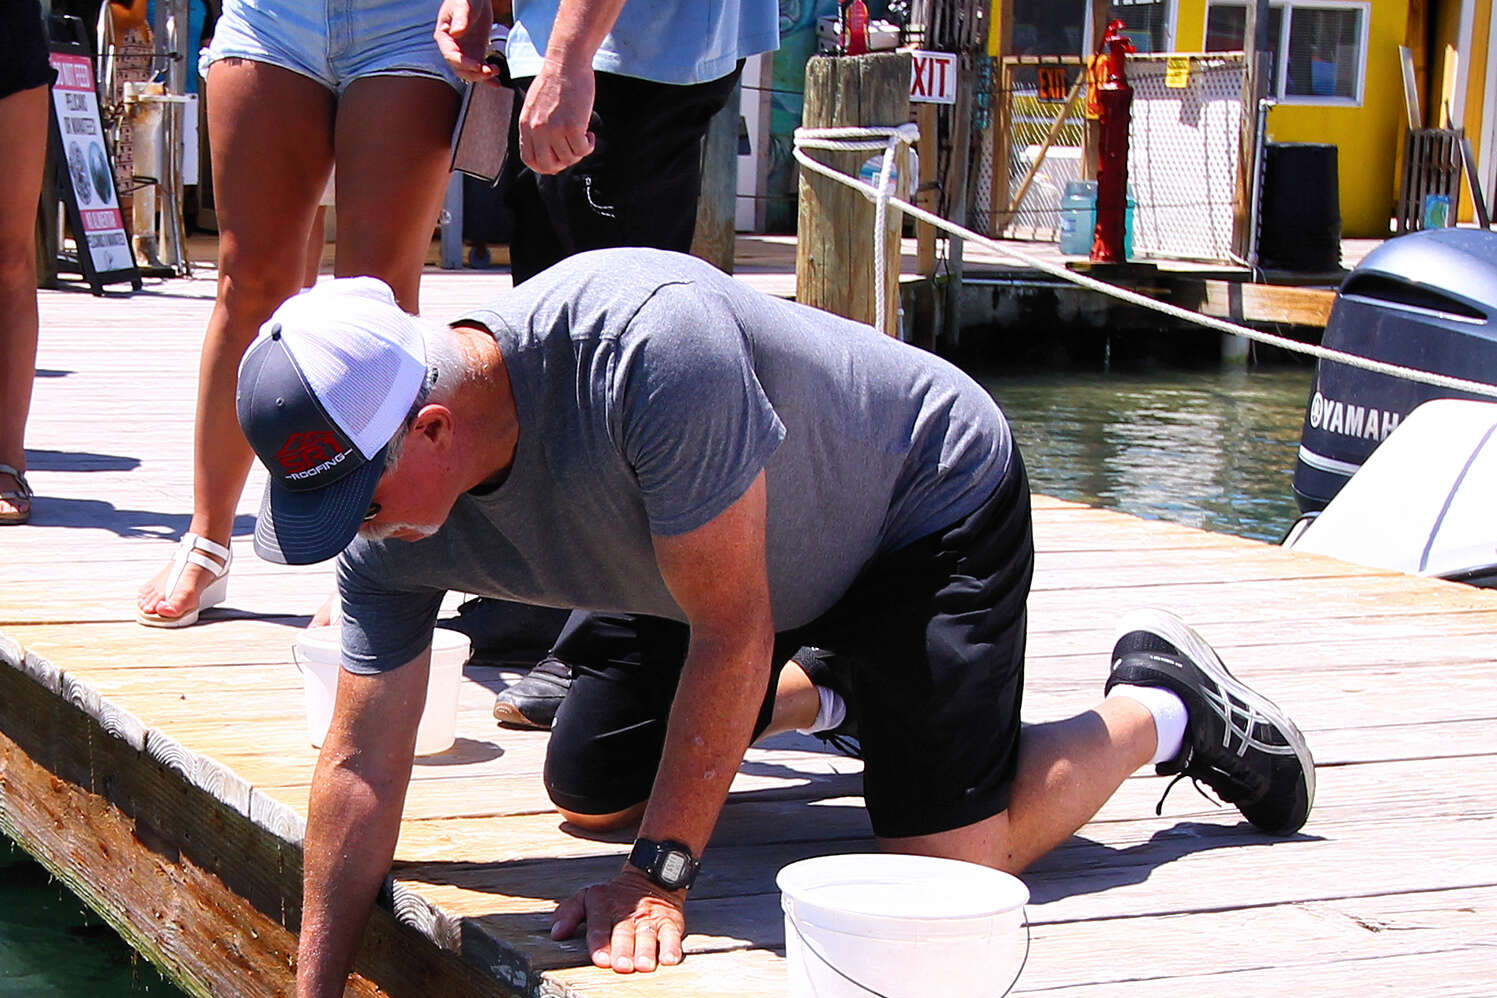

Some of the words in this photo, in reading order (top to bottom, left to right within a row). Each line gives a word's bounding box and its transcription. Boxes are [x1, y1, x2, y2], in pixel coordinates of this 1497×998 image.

[911, 57, 950, 97] XIT
[1322, 398, 1401, 441] YAMAH
[291, 452, 346, 480] ROOFING
